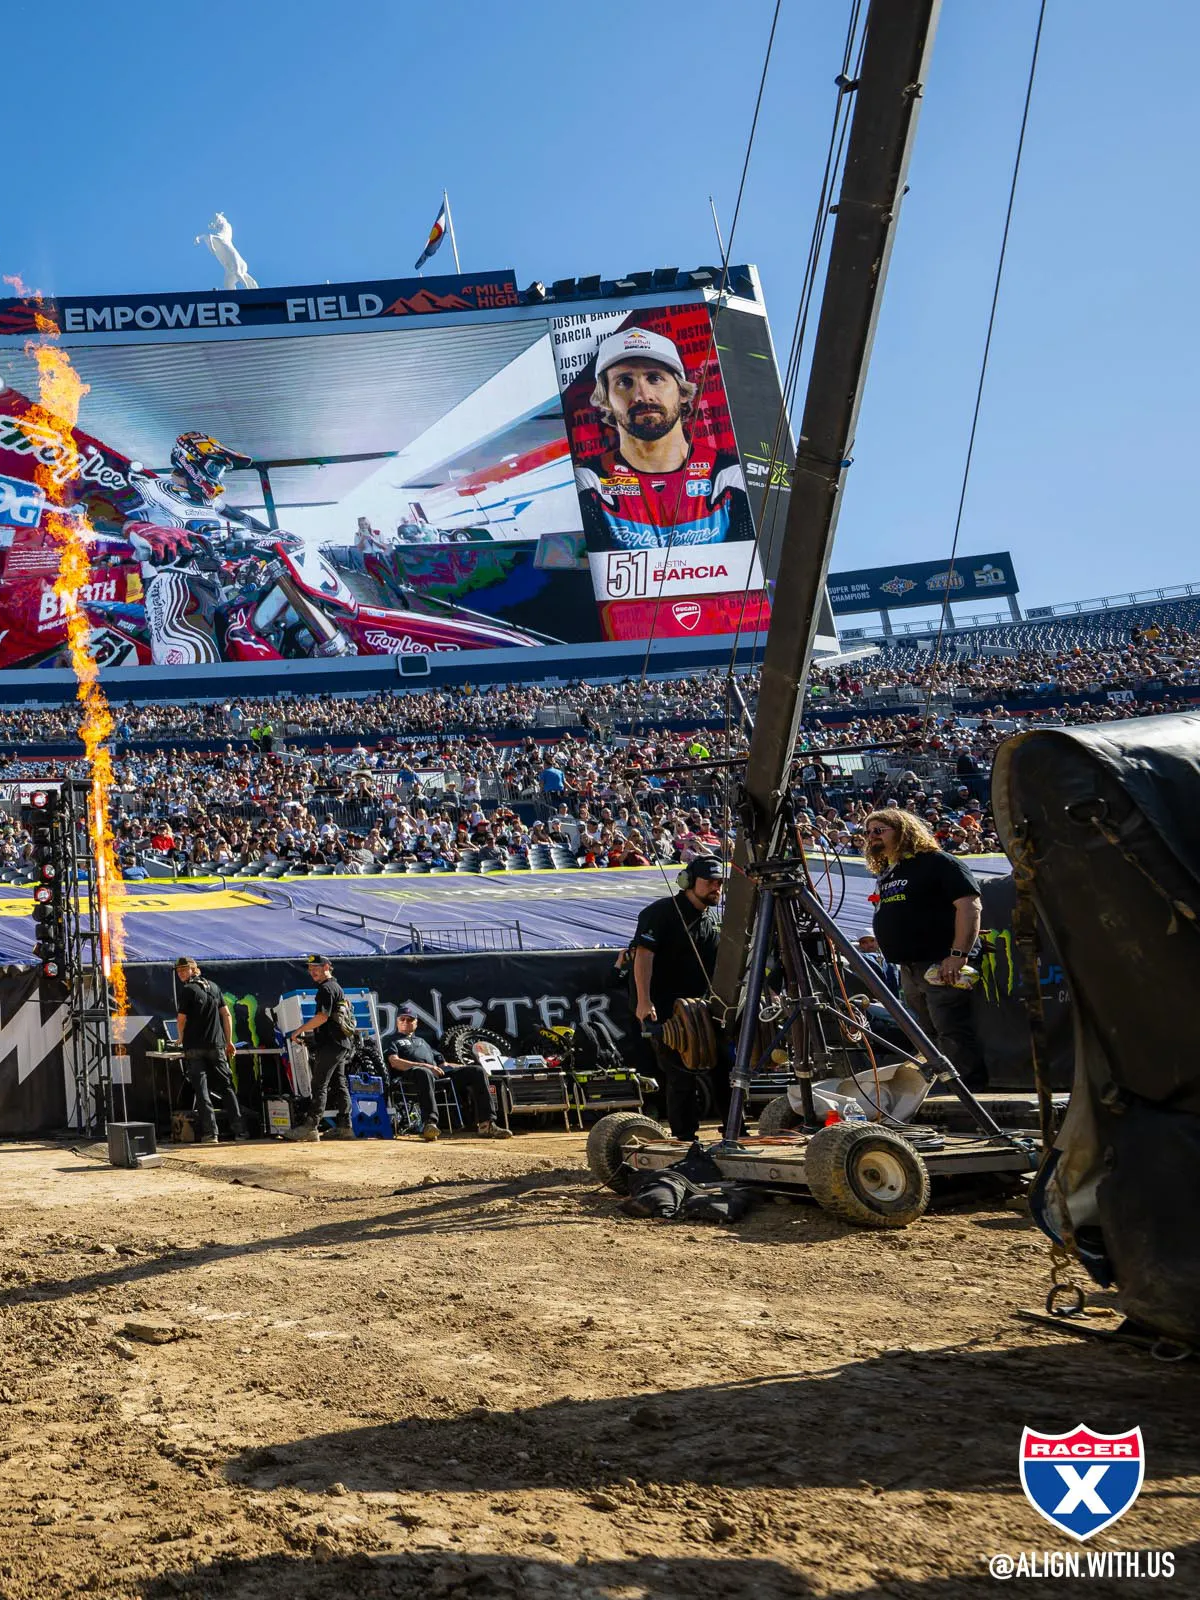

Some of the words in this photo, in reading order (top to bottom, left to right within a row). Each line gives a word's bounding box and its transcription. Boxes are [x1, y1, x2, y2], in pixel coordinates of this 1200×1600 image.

[476, 282, 515, 296] MILE
[64, 302, 242, 331] EMPOWER
[286, 294, 383, 322] FIELD
[461, 285, 475, 295] AT
[477, 294, 520, 308] HIGH
[552, 315, 587, 331] JUSTIN
[554, 327, 592, 345] BARCIA
[560, 352, 594, 370] JUSTIN
[687, 480, 712, 496] PPG
[655, 560, 687, 569] JUSTIN
[606, 551, 648, 598] 51
[653, 565, 728, 582] BARCIA
[828, 584, 850, 595] SUPER
[851, 583, 871, 593] BOWL
[830, 591, 871, 602] CHAMPIONS
[675, 604, 698, 613] DUCATI
[396, 734, 438, 744] EMPOWER
[441, 733, 466, 741] FIELD
[366, 988, 626, 1042] ONSTER
